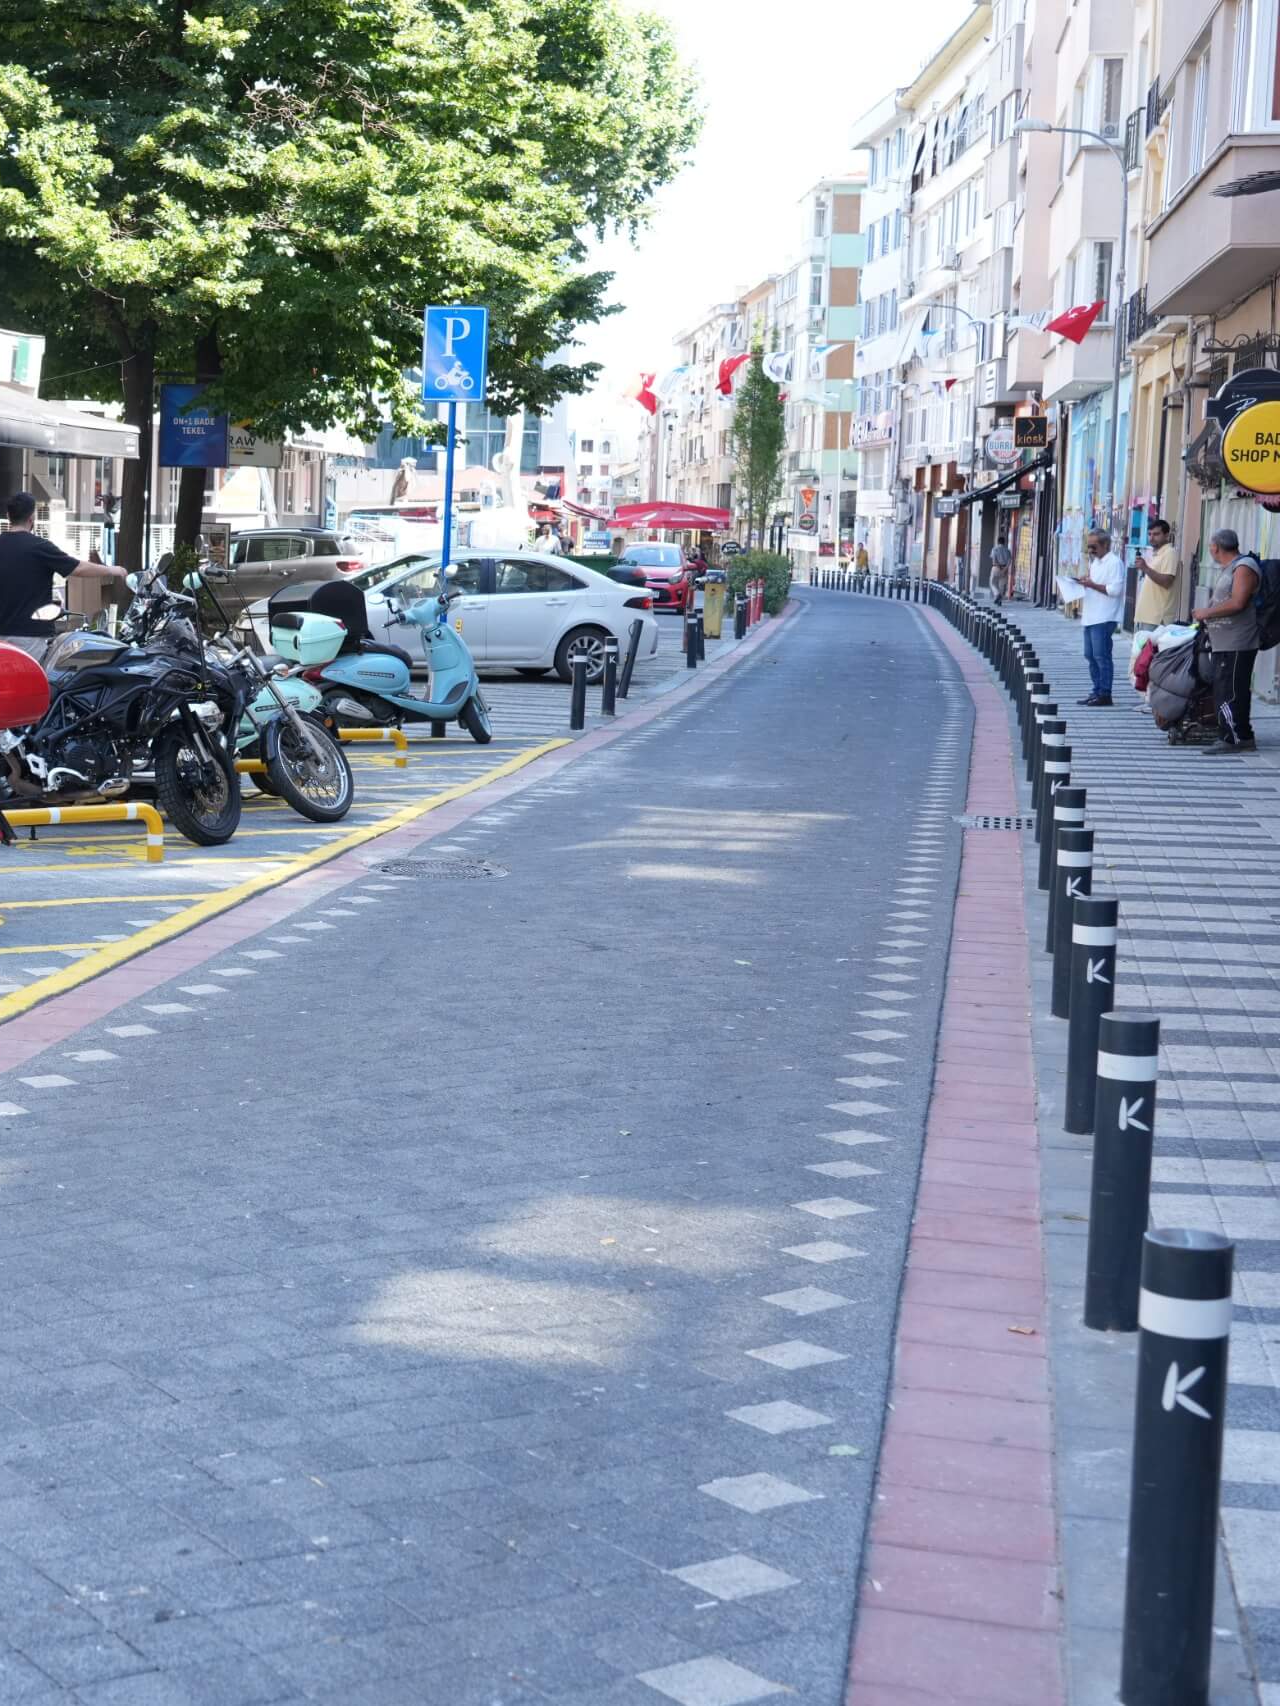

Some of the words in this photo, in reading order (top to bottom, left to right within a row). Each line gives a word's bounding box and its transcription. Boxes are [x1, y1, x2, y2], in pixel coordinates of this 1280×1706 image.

[440, 317, 471, 357] P
[182, 426, 206, 435] TEKEL
[1016, 432, 1045, 445] kiosk
[1231, 449, 1270, 462] SHOP
